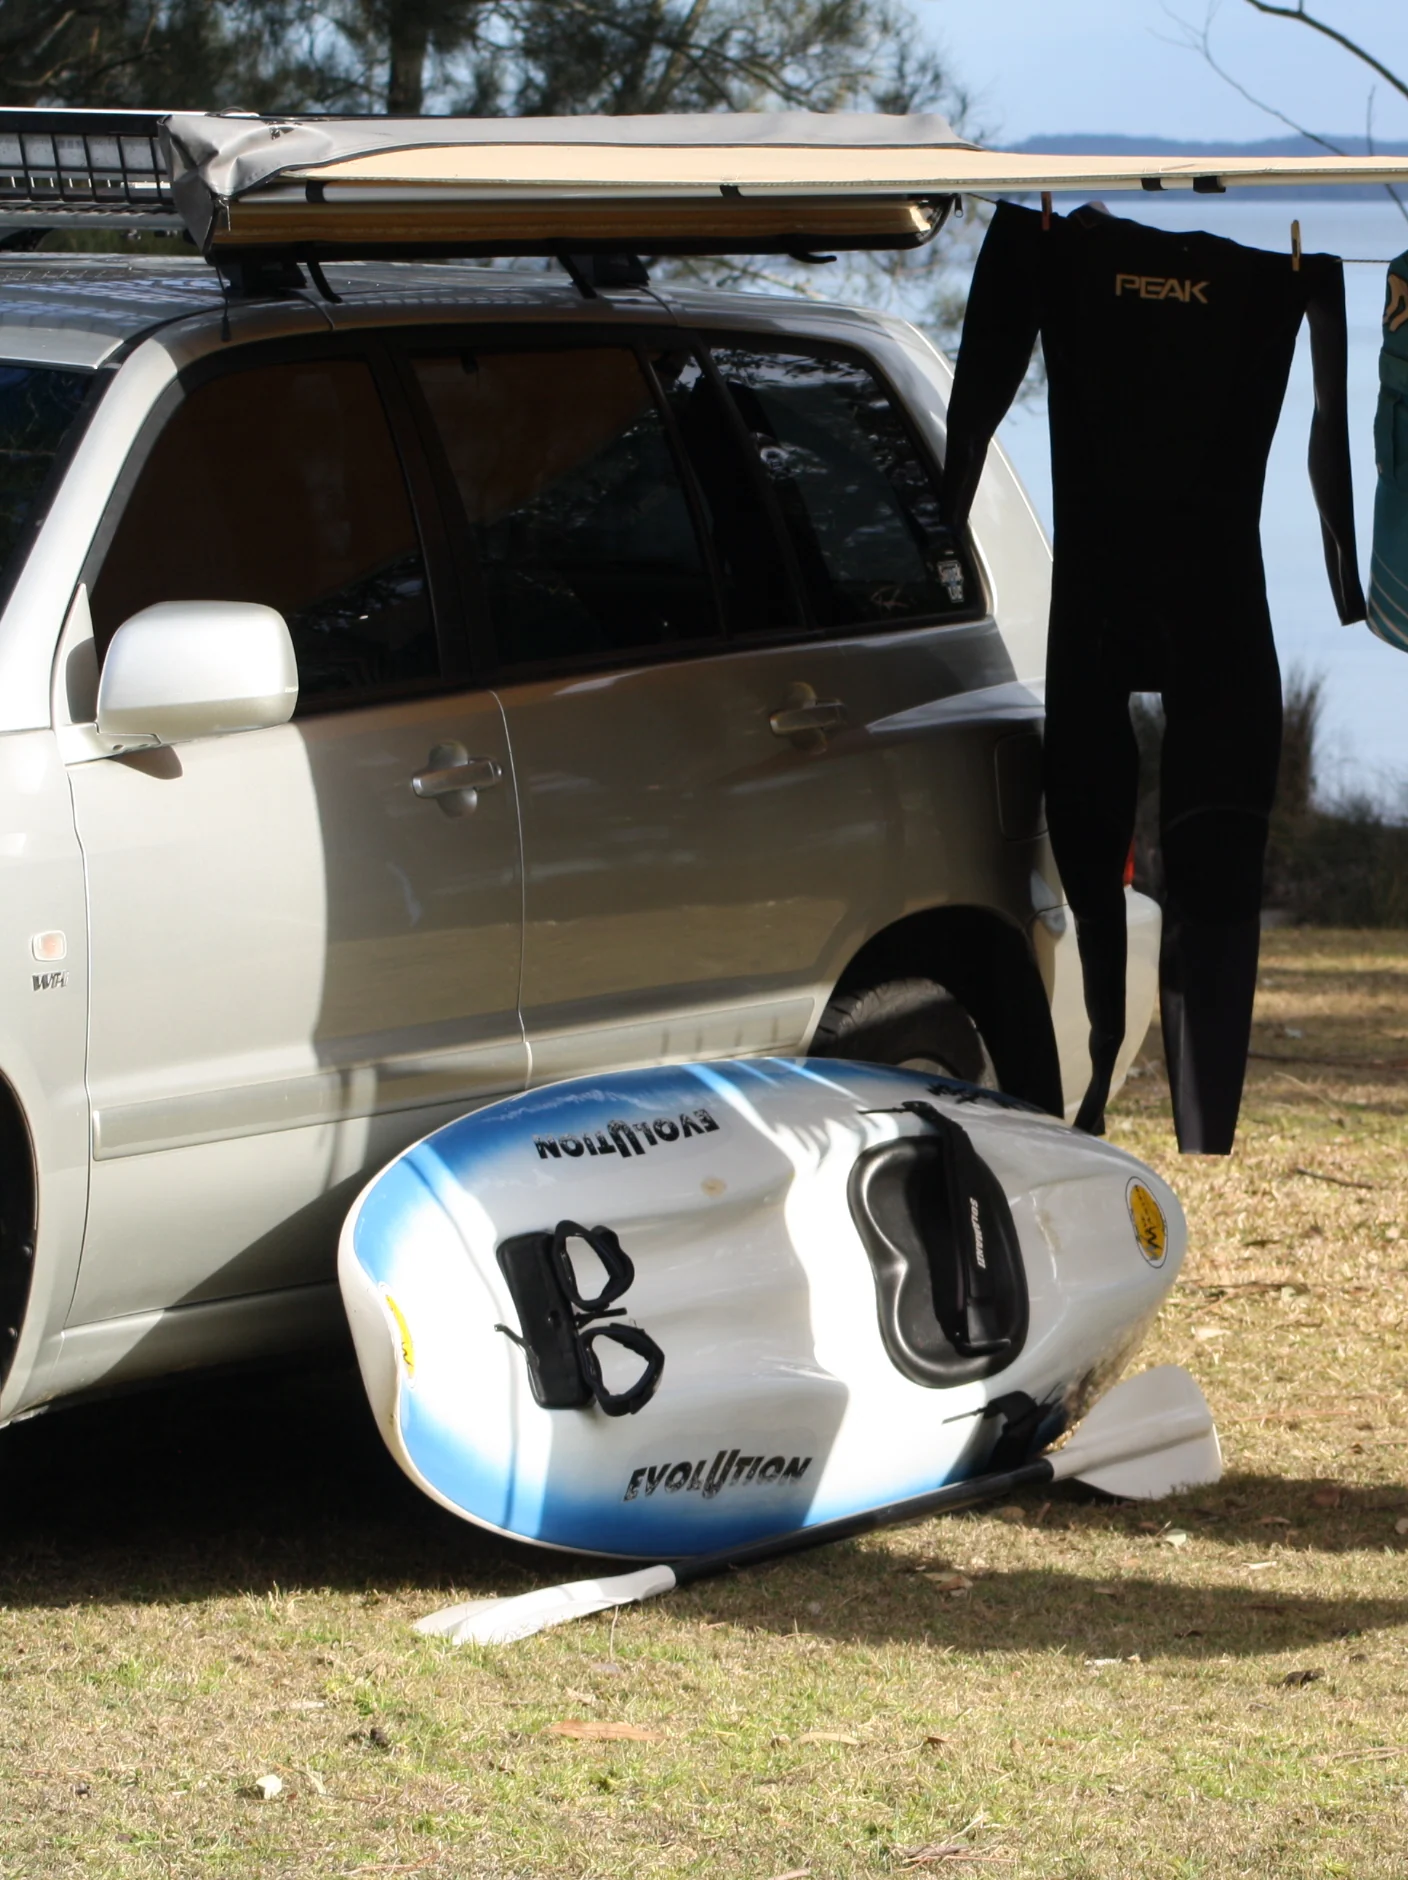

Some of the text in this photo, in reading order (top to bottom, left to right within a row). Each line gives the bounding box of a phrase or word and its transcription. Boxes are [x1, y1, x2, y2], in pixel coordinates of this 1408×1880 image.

[1115, 273, 1210, 304] PEAK
[532, 1108, 721, 1160] EVOLUTION
[622, 1448, 814, 1502] EVOLUTION
